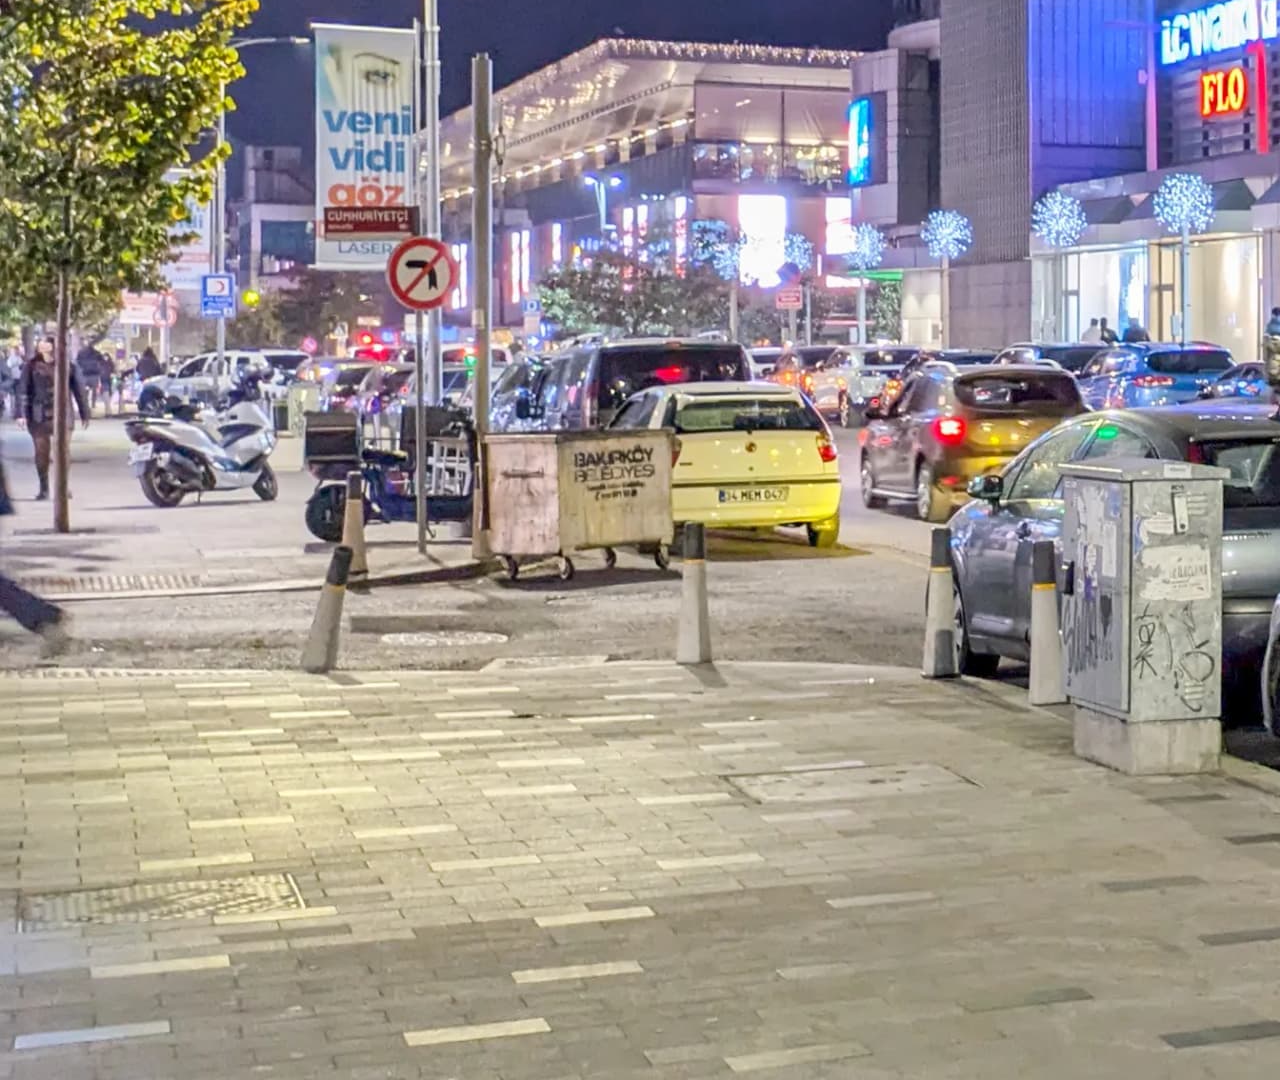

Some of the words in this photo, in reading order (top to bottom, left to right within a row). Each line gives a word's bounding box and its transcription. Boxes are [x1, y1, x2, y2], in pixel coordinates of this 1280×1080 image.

[1202, 67, 1245, 115] FLO
[322, 104, 411, 136] veni
[328, 140, 405, 172] vidi
[328, 176, 405, 207] göz
